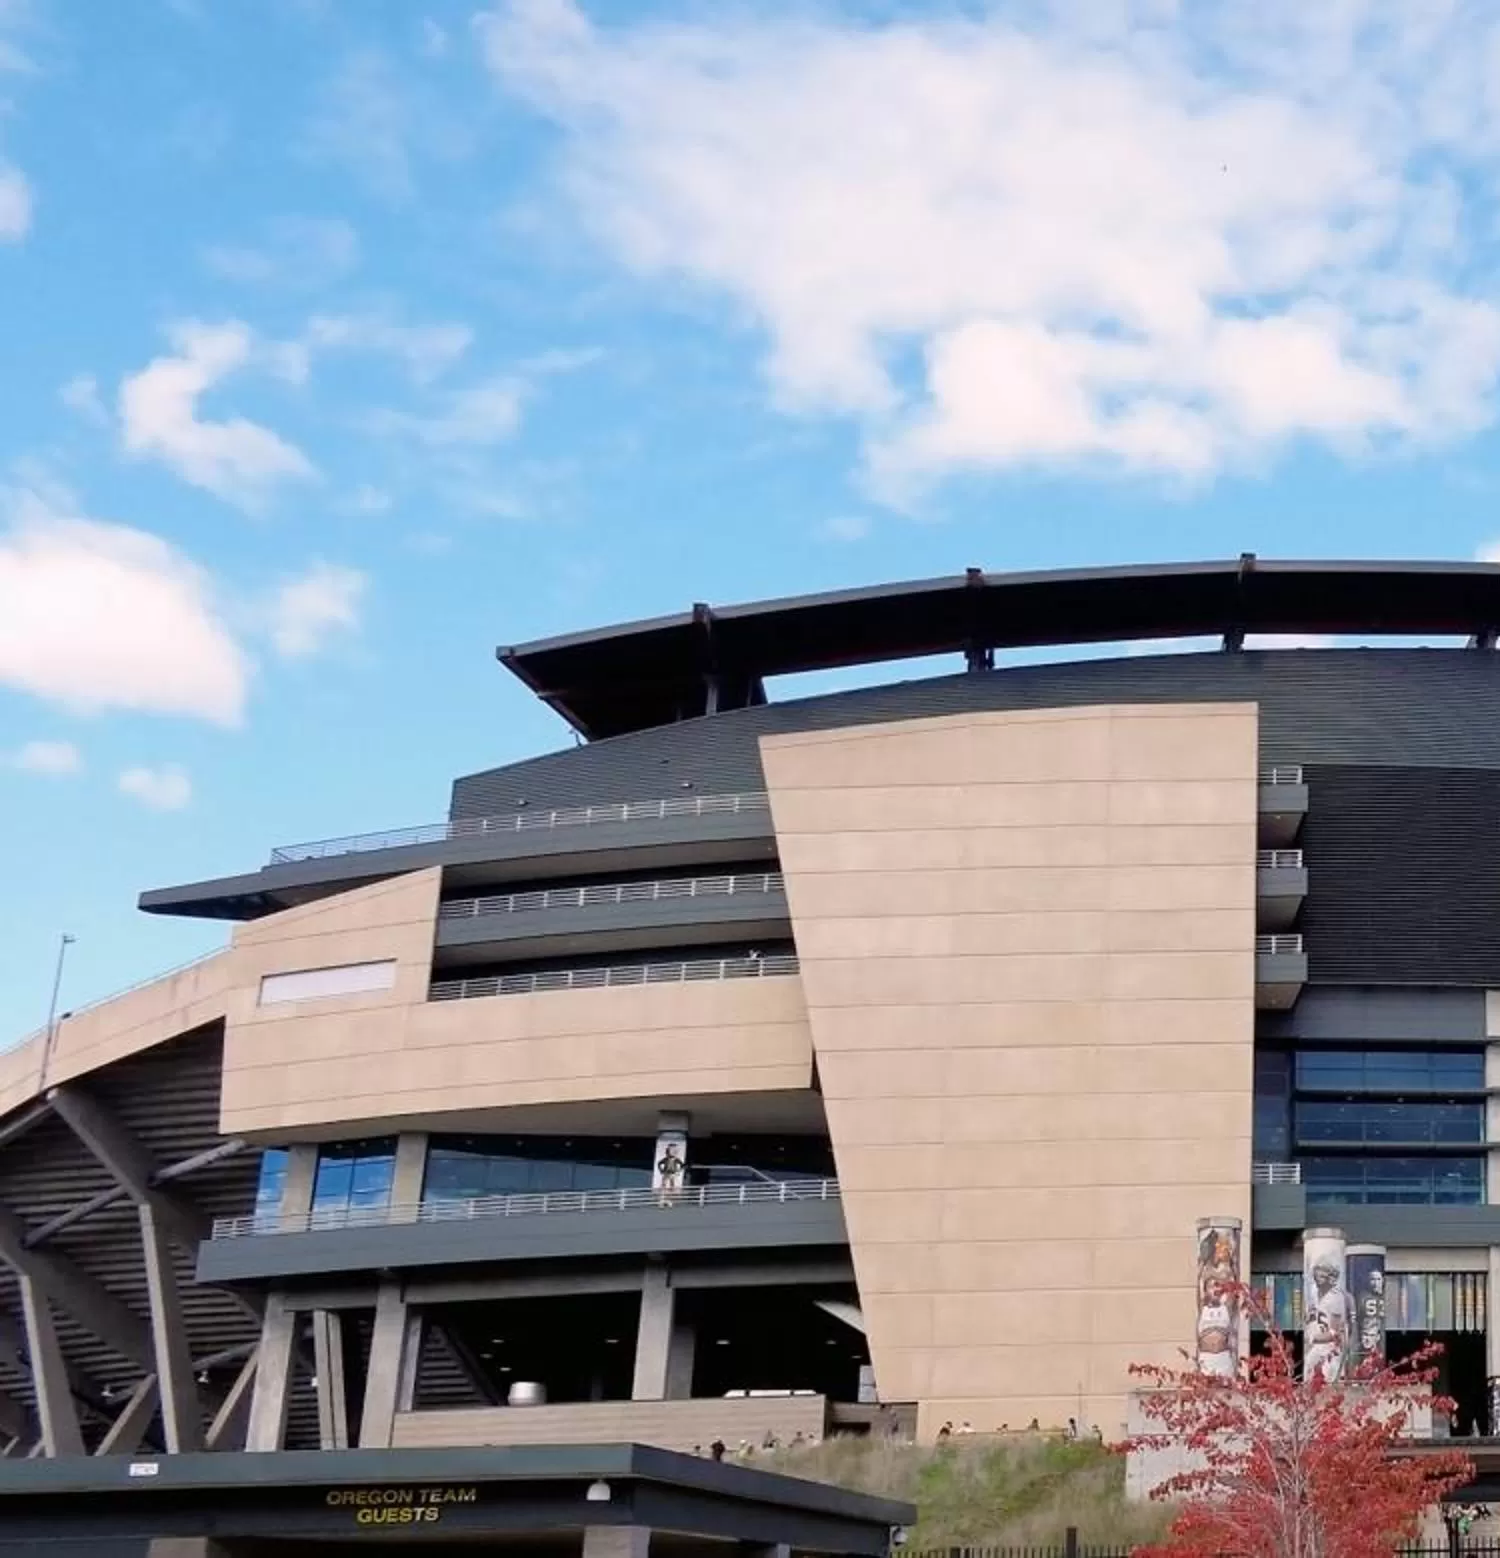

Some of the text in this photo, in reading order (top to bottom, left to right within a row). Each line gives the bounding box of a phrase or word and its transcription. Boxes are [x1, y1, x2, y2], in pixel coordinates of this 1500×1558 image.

[326, 1488, 477, 1505] OREGON TEAM
[356, 1507, 439, 1523] GUESTS
